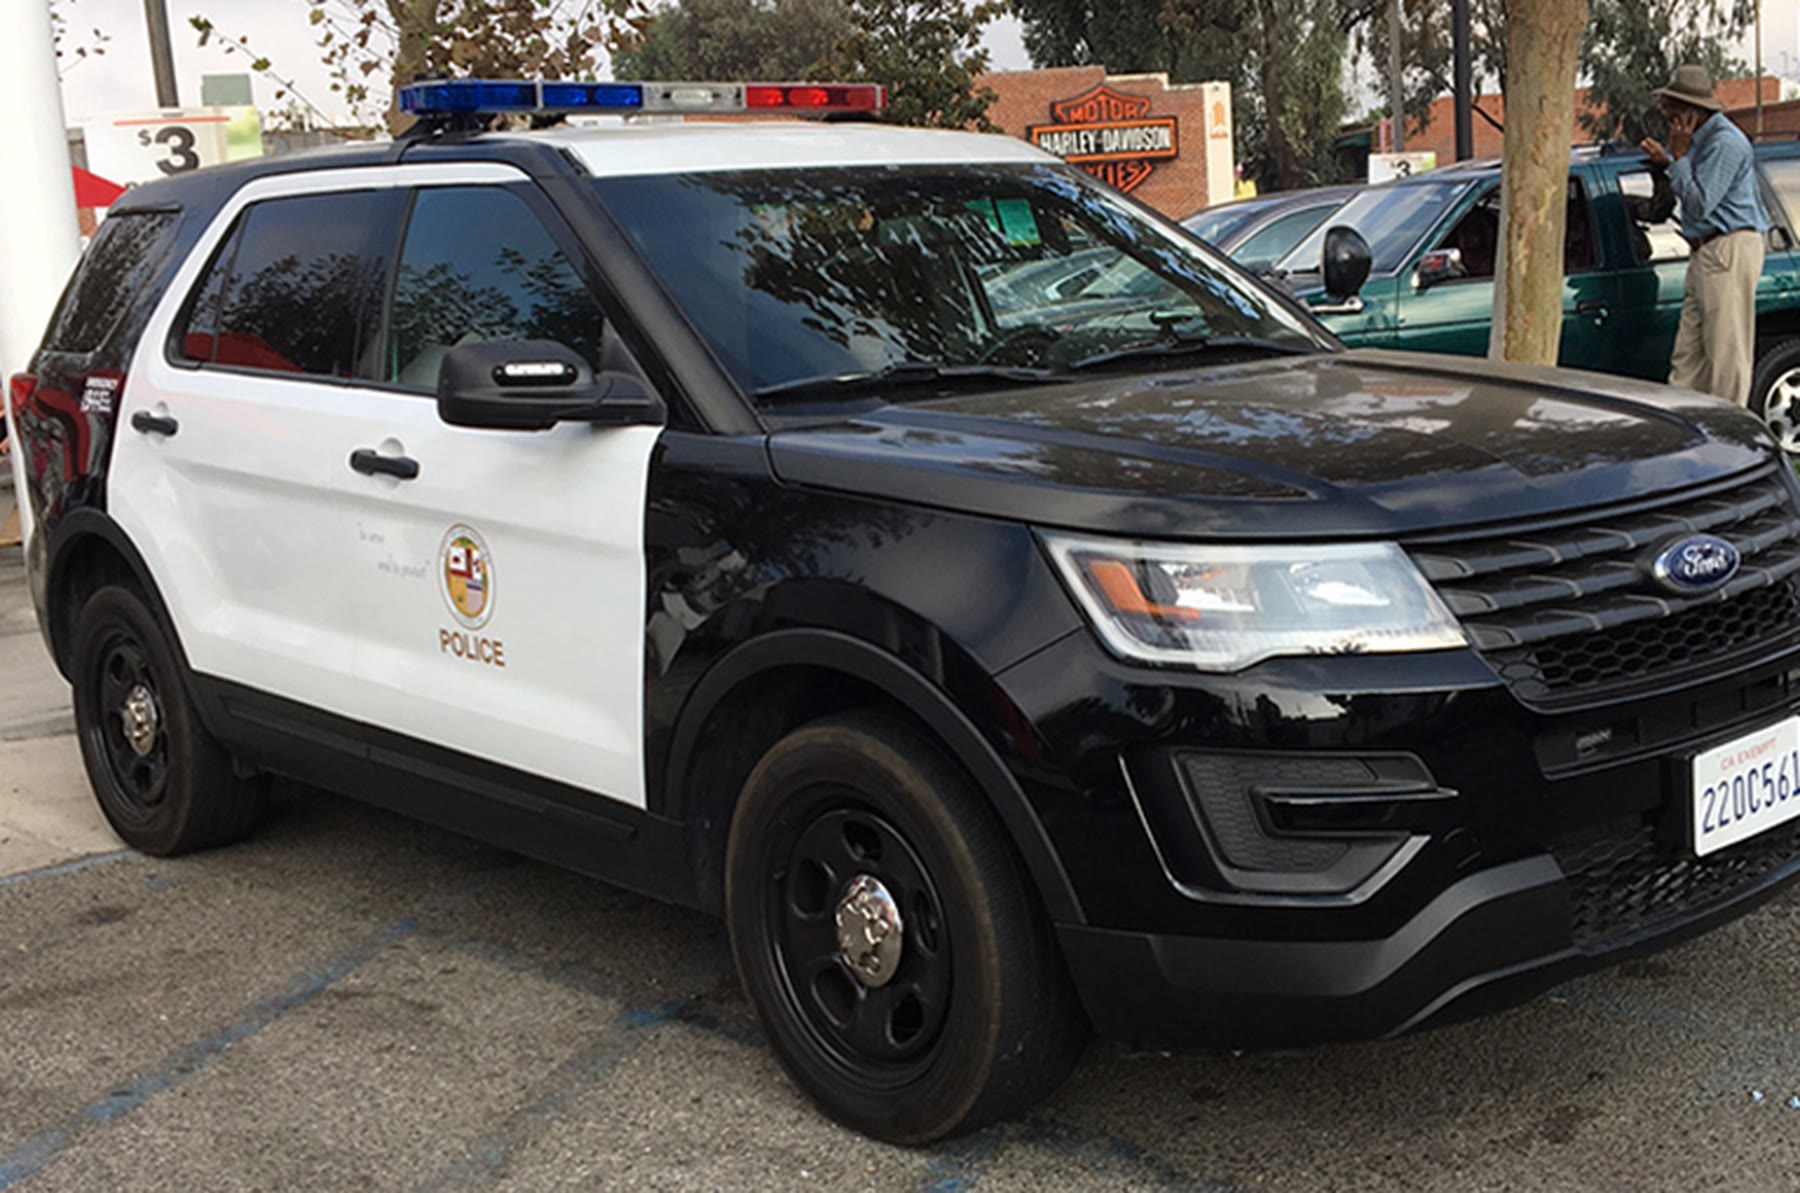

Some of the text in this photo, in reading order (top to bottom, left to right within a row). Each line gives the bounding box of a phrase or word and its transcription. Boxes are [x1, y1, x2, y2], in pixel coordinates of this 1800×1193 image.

[1069, 95, 1138, 122] MOTOR
[1040, 126, 1171, 155] HARLEY-DAVIDSON
[1084, 161, 1141, 188] CLES
[1682, 543, 1728, 577] Ford
[439, 628, 505, 668] POLICE
[1737, 737, 1777, 764] EXEMPT
